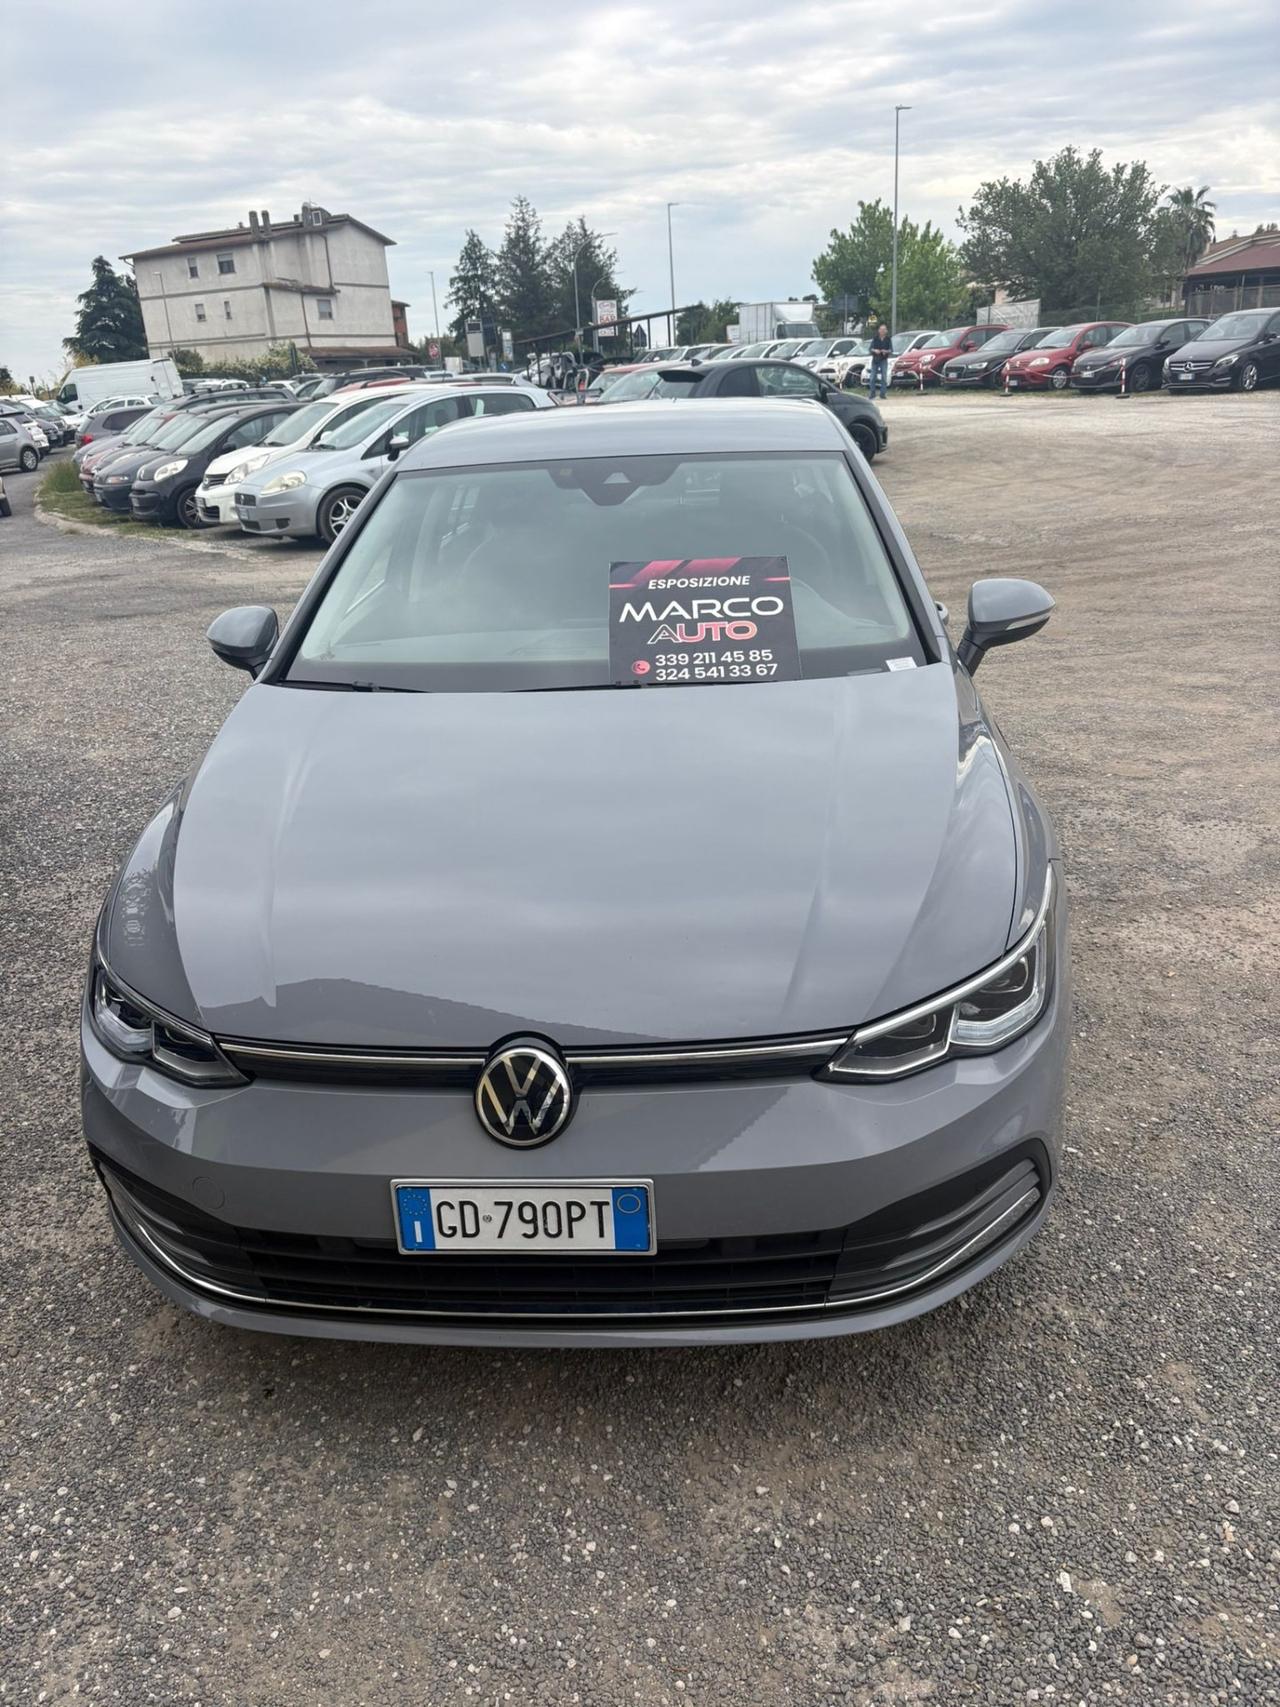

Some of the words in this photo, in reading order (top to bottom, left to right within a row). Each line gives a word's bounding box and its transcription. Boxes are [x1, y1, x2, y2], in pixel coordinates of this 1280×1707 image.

[648, 575, 750, 590] ESPOSIZIONE
[619, 596, 784, 623] MARCO
[647, 620, 758, 645] AUTO
[655, 653, 689, 666] 339
[692, 651, 716, 665] 211
[720, 650, 745, 663] 45
[748, 649, 773, 662] 85
[655, 667, 690, 681] 324
[694, 666, 725, 679] 541
[729, 664, 752, 677] 33
[755, 663, 778, 676] 67
